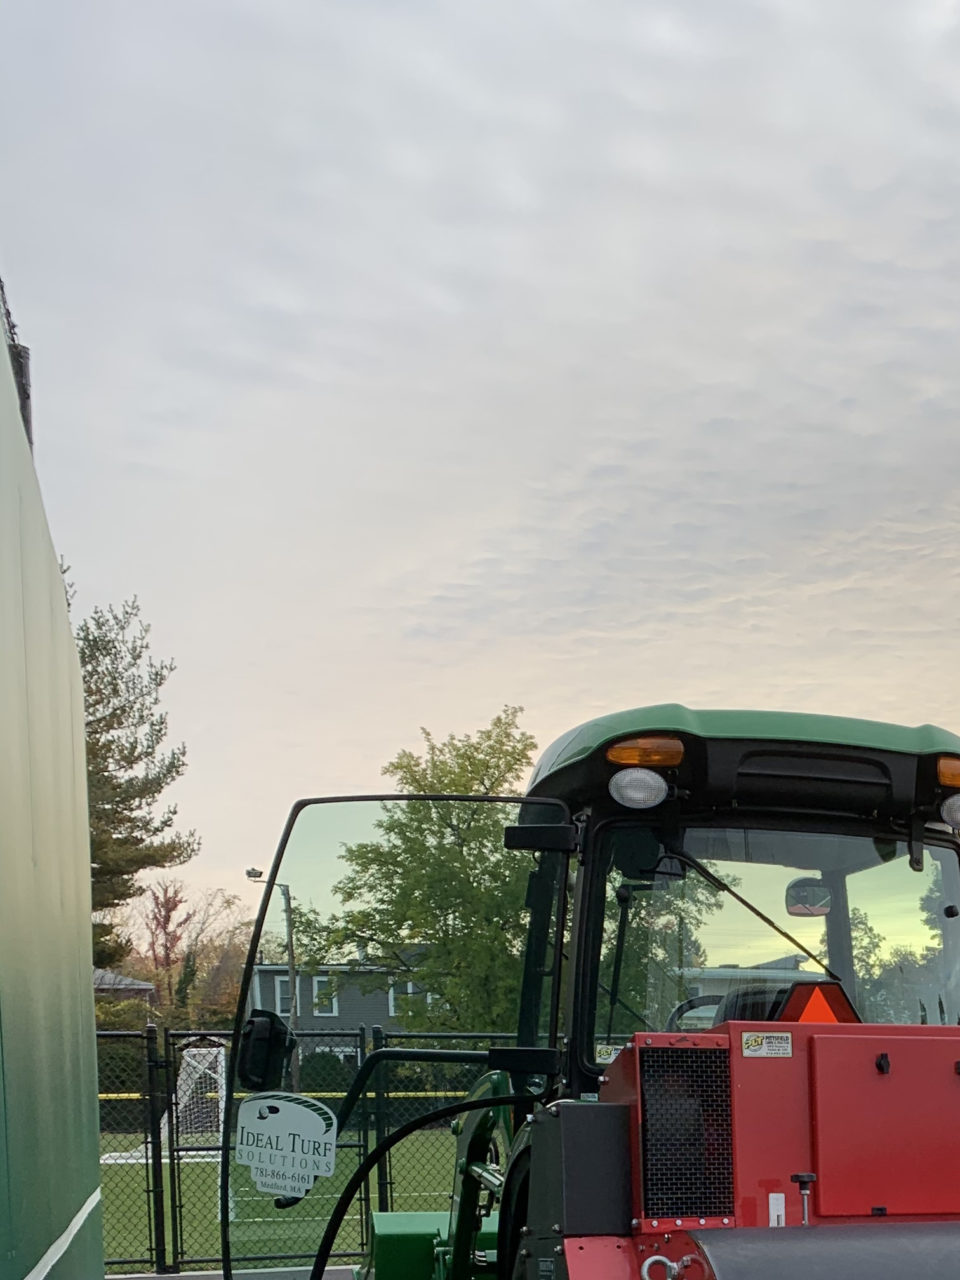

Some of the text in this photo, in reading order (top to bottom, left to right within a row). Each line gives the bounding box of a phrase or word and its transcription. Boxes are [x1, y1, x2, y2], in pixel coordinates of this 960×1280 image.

[239, 1126, 333, 1157] IDEAL TURF
[237, 1149, 332, 1173] SOLUTIONS
[254, 1167, 311, 1185] 781-866-6161
[290, 1185, 302, 1194] MA
